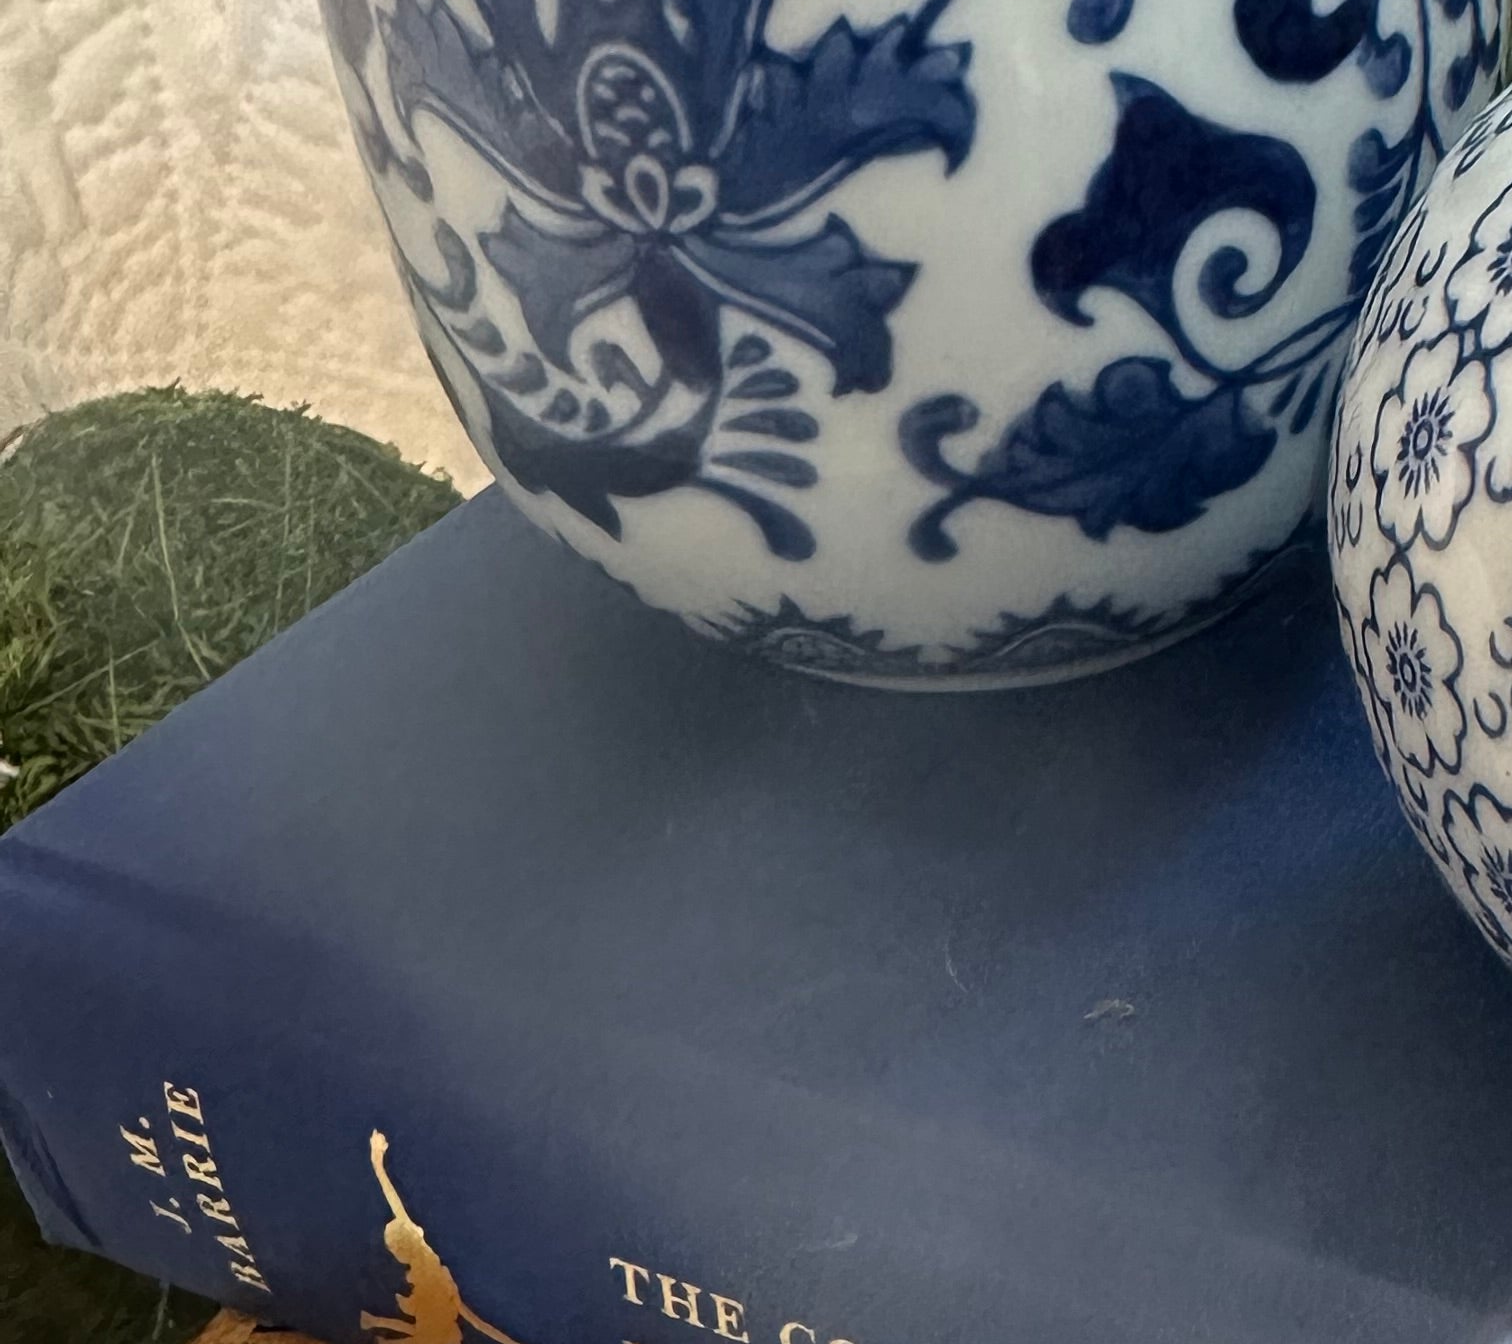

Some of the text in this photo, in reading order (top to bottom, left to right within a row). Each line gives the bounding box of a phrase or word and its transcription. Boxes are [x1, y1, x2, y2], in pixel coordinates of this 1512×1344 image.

[119, 1115, 167, 1177] M.
[163, 1080, 273, 1294] BARRIE
[609, 1256, 750, 1344] THE
